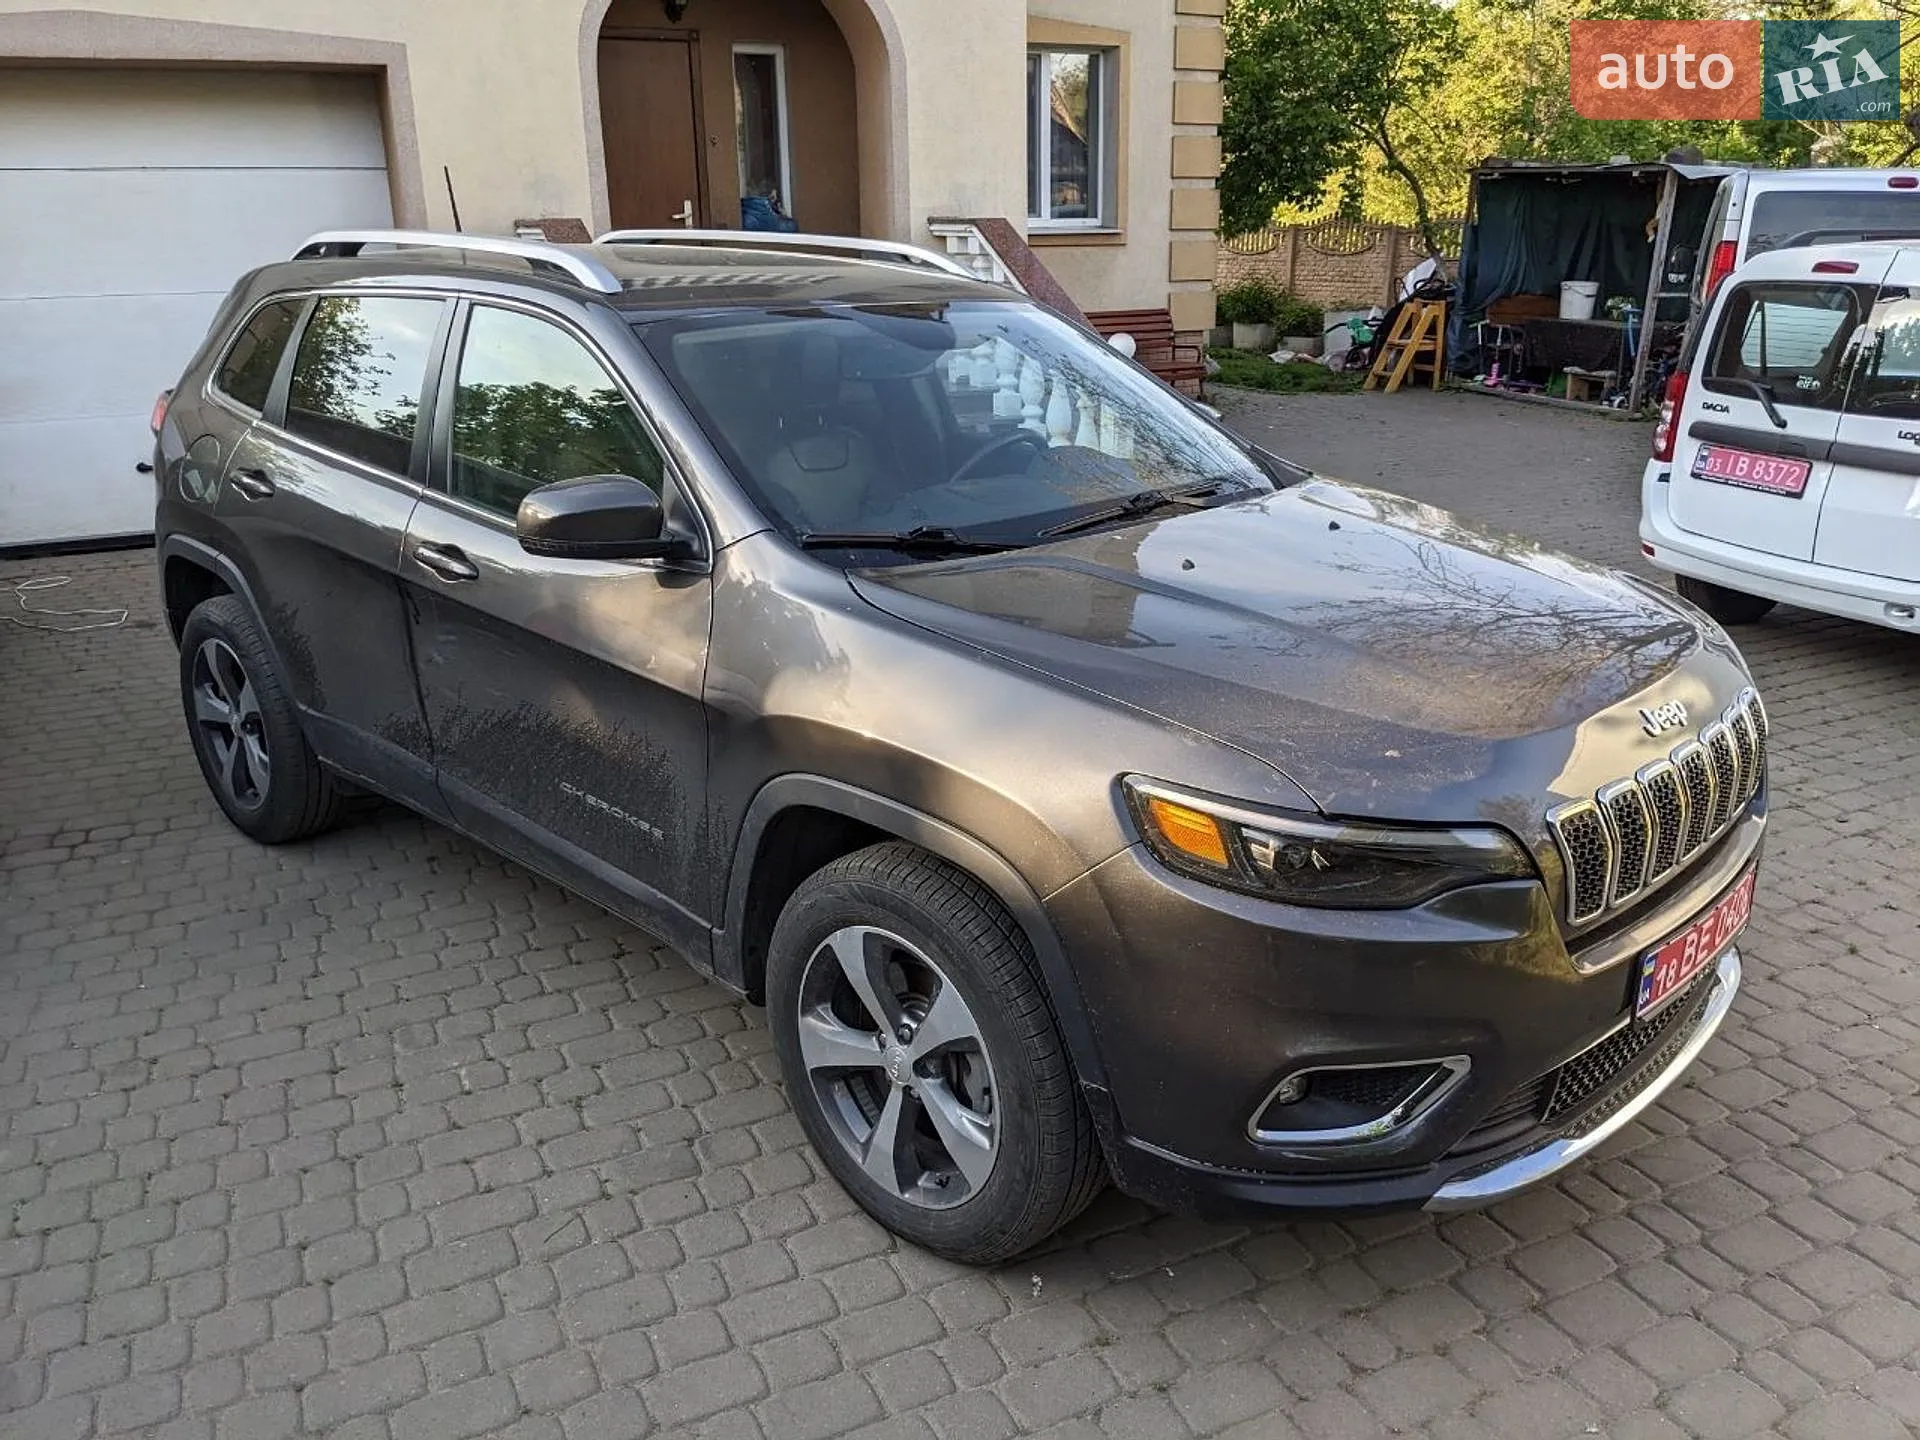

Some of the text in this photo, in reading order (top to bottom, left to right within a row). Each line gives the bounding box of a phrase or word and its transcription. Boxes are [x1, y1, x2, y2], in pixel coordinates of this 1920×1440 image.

[1702, 402, 1730, 414] DACIA
[1752, 460, 1800, 487] 8372
[1636, 699, 1689, 738] Jeep
[1655, 958, 1678, 996] 18
[1679, 917, 1715, 977] BE
